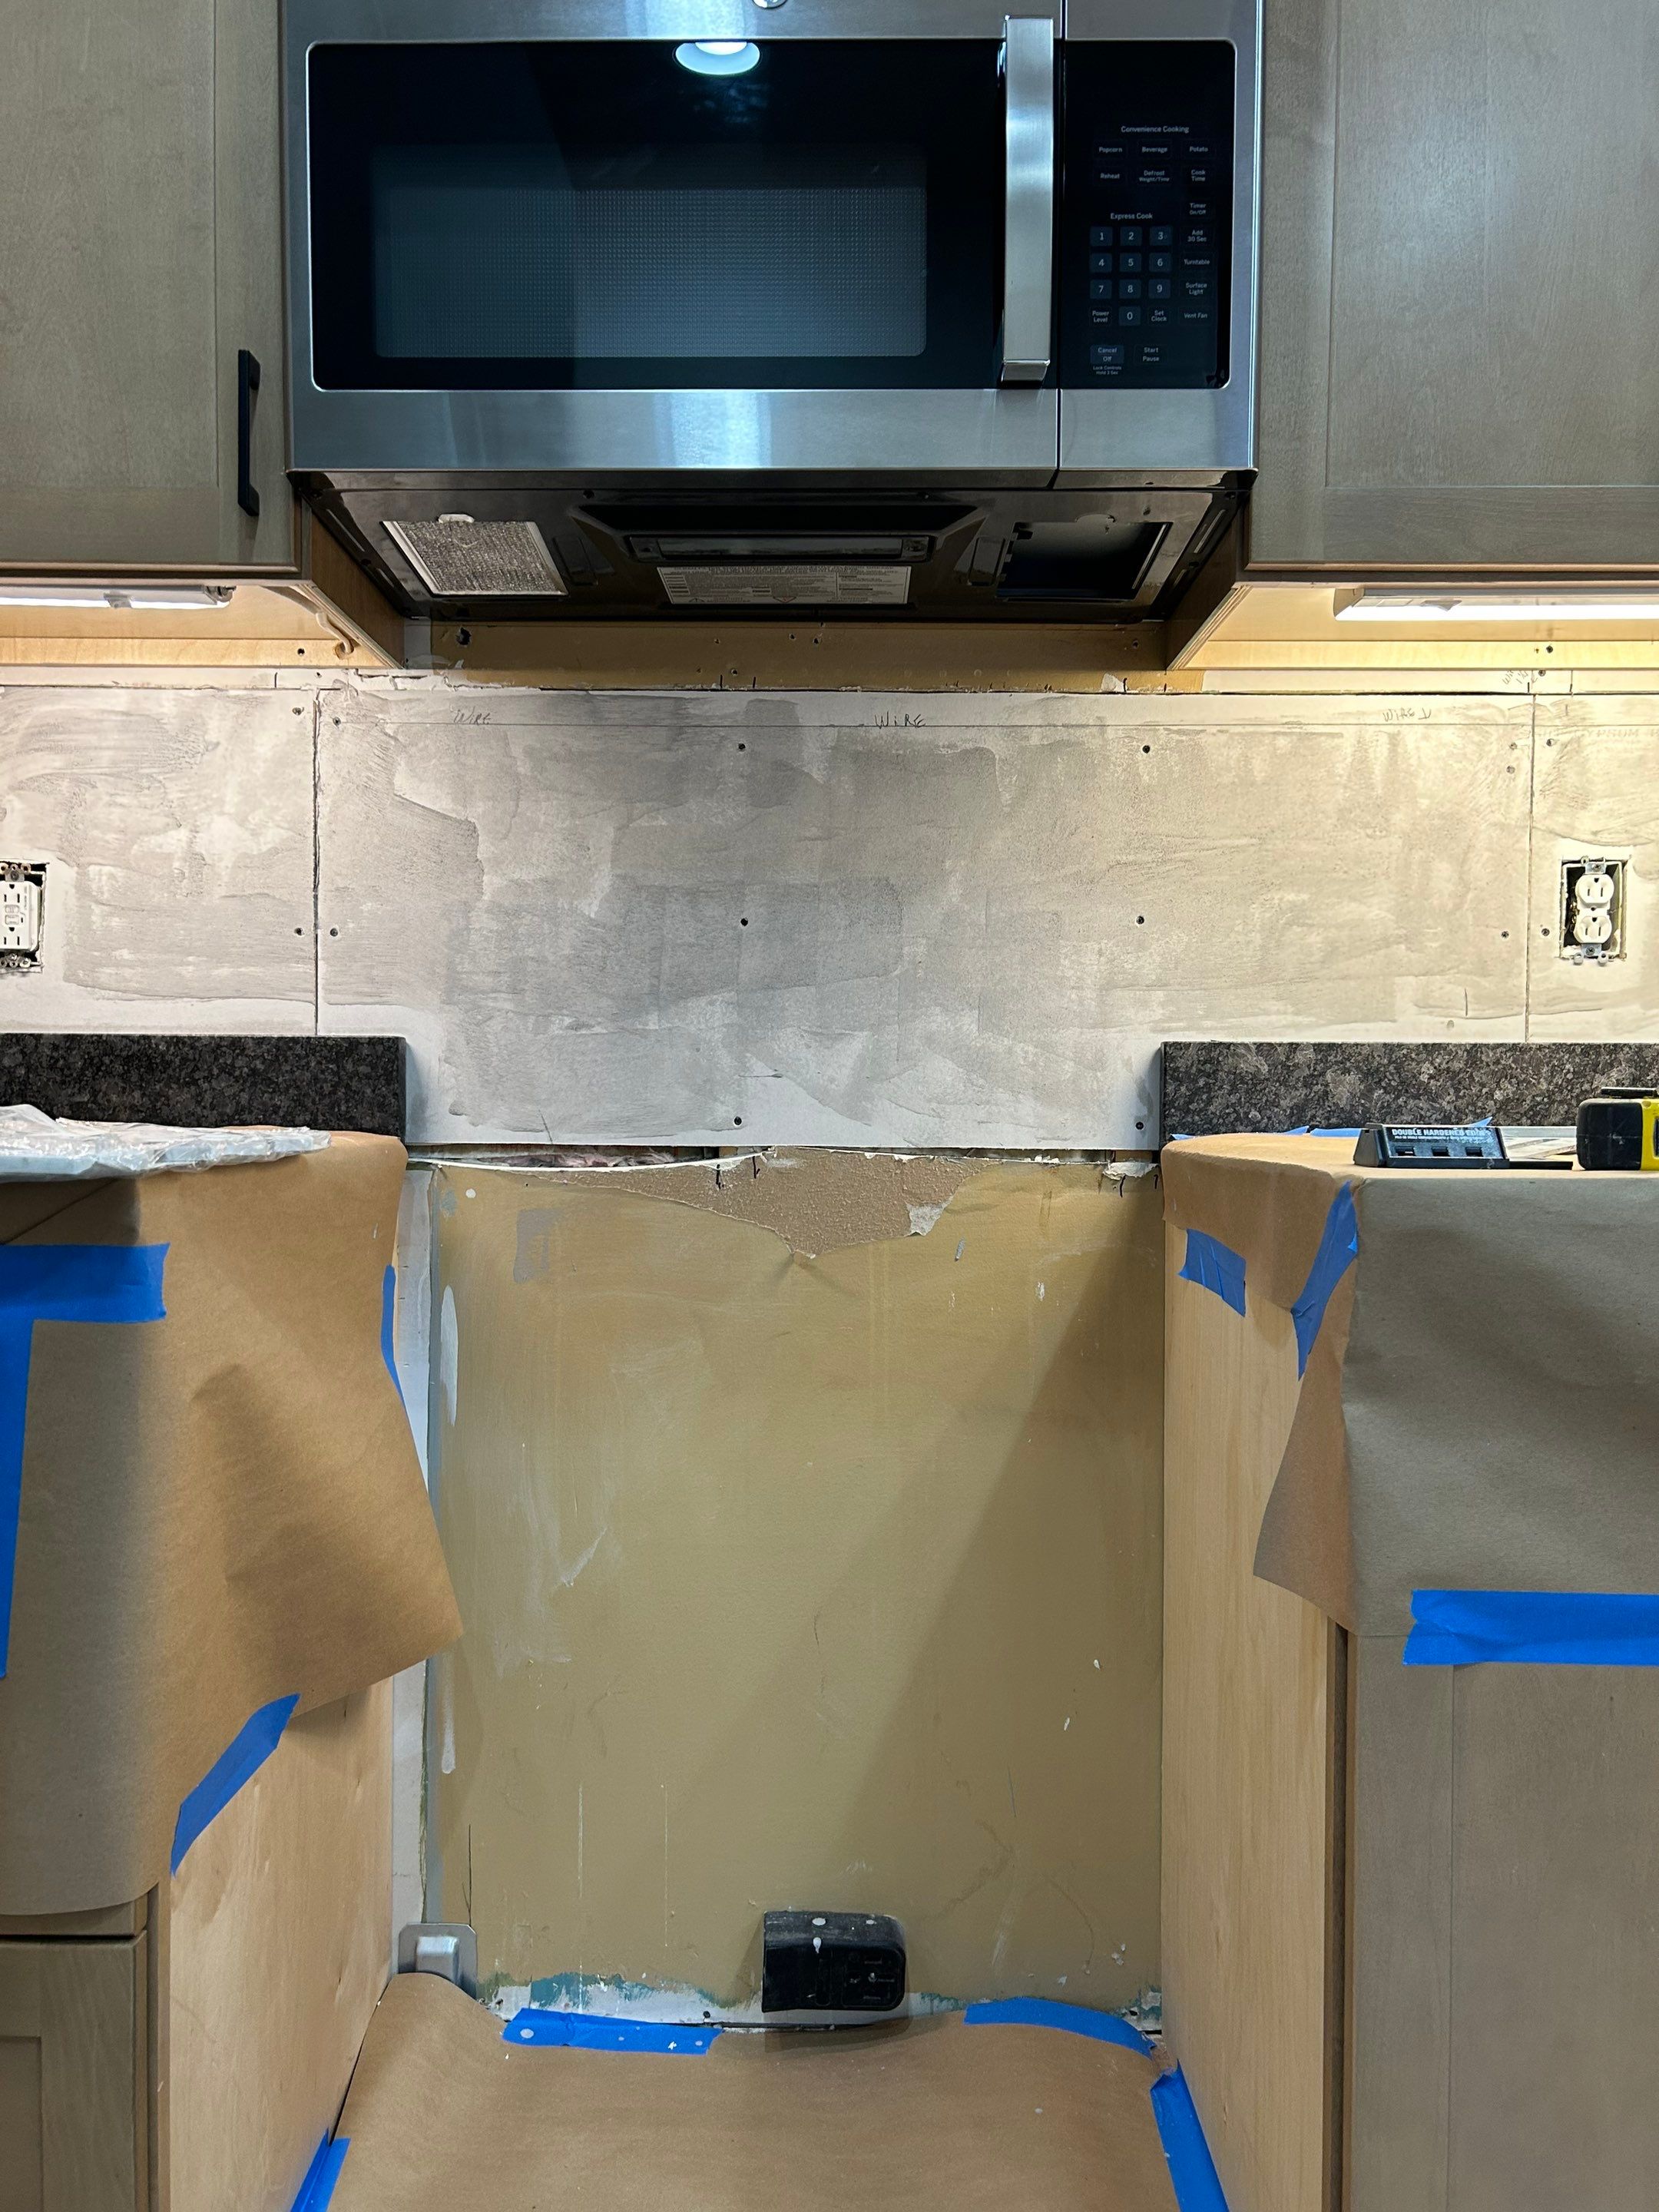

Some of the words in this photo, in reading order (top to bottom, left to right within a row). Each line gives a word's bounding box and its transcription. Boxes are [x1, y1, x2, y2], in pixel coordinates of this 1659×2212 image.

[1121, 125, 1162, 134] Convenience
[1162, 125, 1190, 134] Cooking
[1141, 146, 1168, 154] Beverage
[1110, 212, 1135, 221] Express
[1099, 232, 1104, 241] 1
[1128, 231, 1134, 240] 2
[1157, 231, 1164, 240] 3
[1098, 258, 1105, 267] 4
[1128, 258, 1134, 267] 5
[1157, 258, 1164, 267] 6
[1098, 285, 1104, 294] 7
[1128, 284, 1134, 293] 8
[1156, 284, 1163, 293] 9
[1126, 311, 1134, 320] 0
